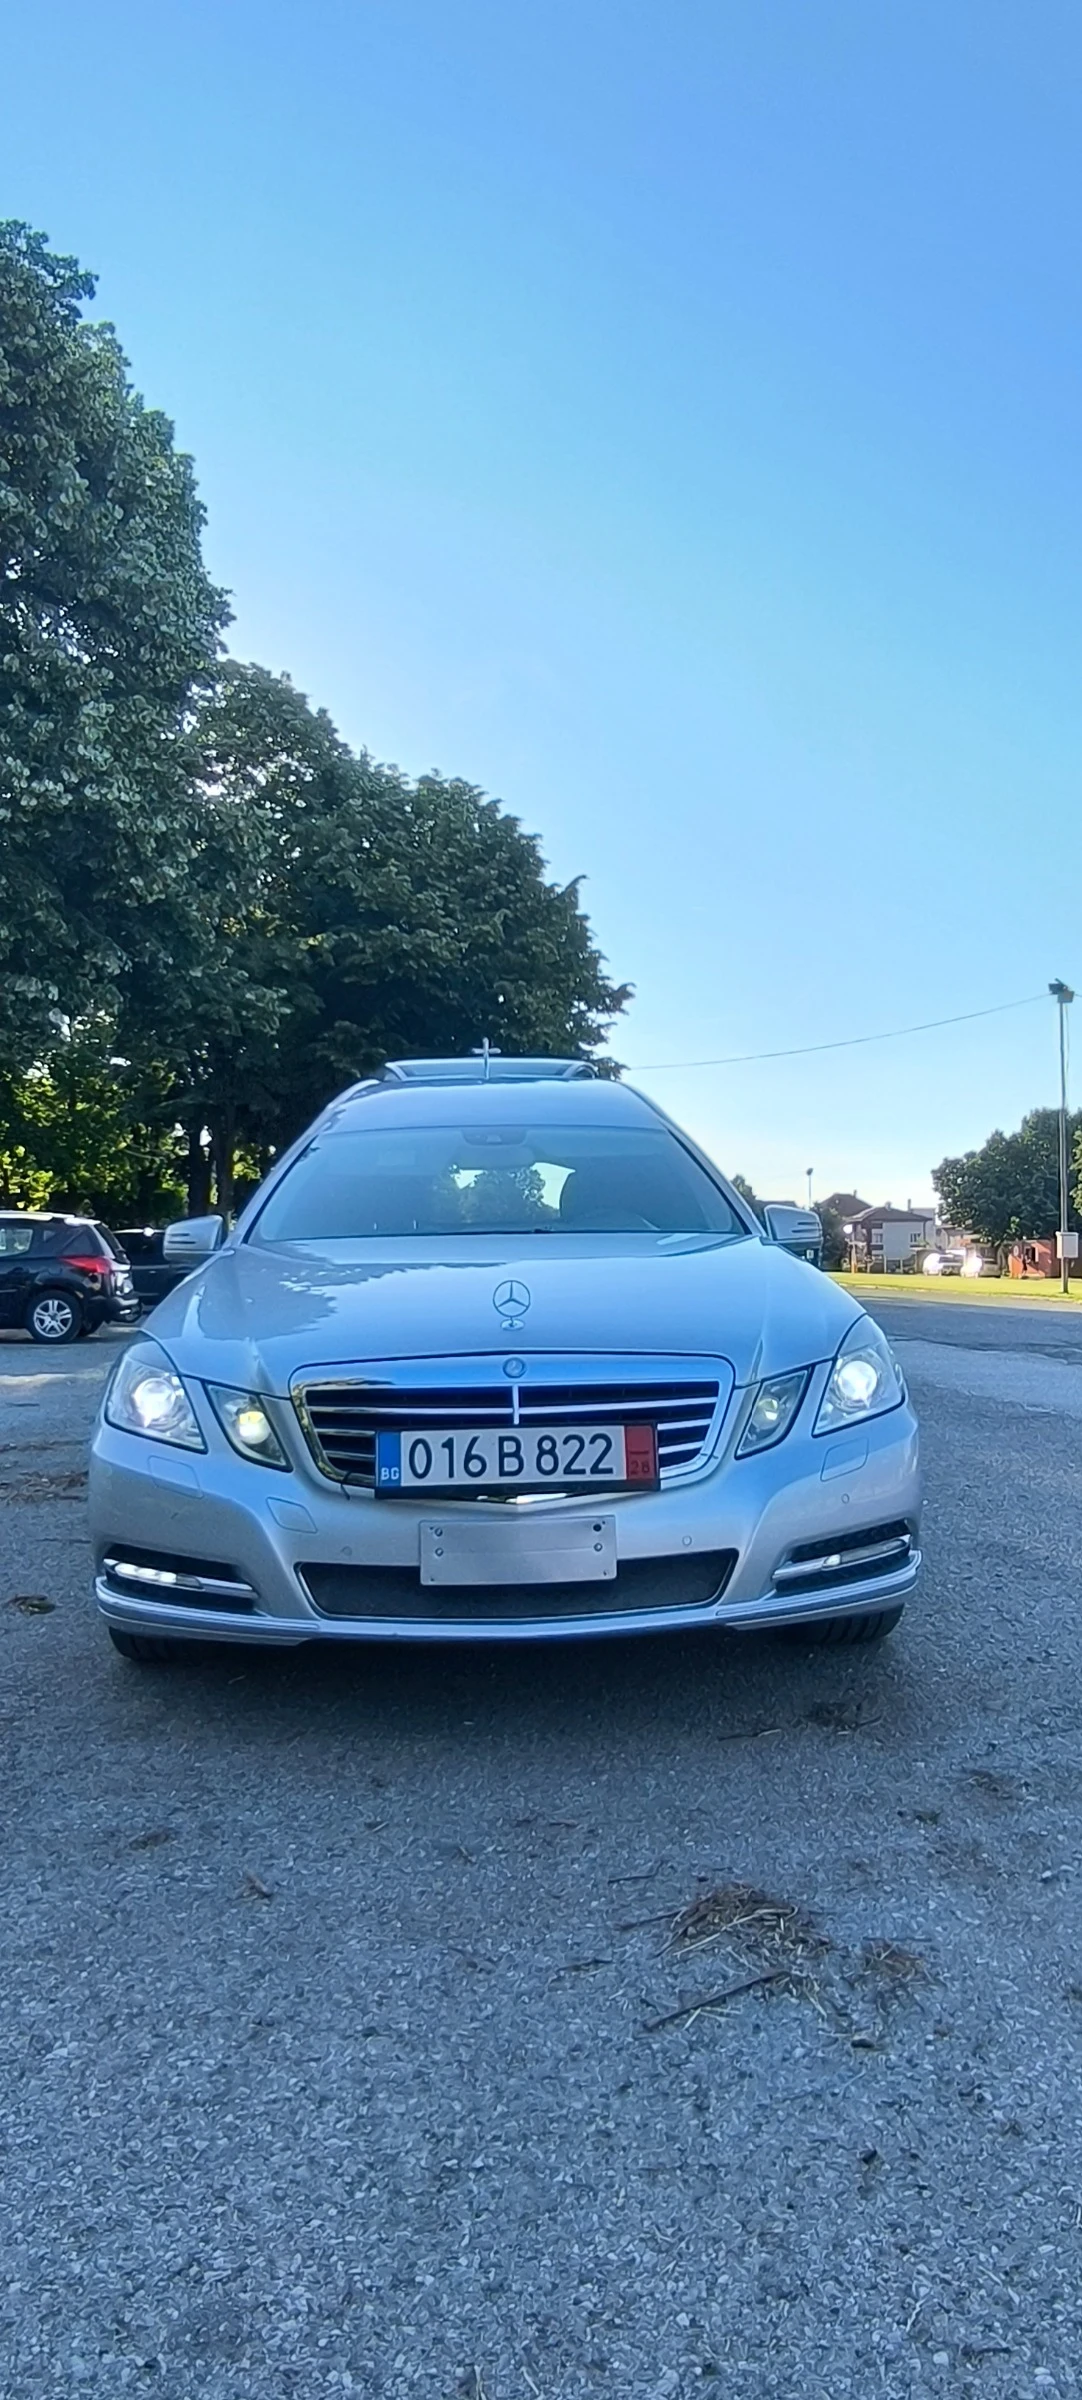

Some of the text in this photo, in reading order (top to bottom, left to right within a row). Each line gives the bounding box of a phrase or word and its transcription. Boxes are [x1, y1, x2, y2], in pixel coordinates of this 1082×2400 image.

[408, 1433, 614, 1479] 016 B 822
[380, 1467, 400, 1481] BG
